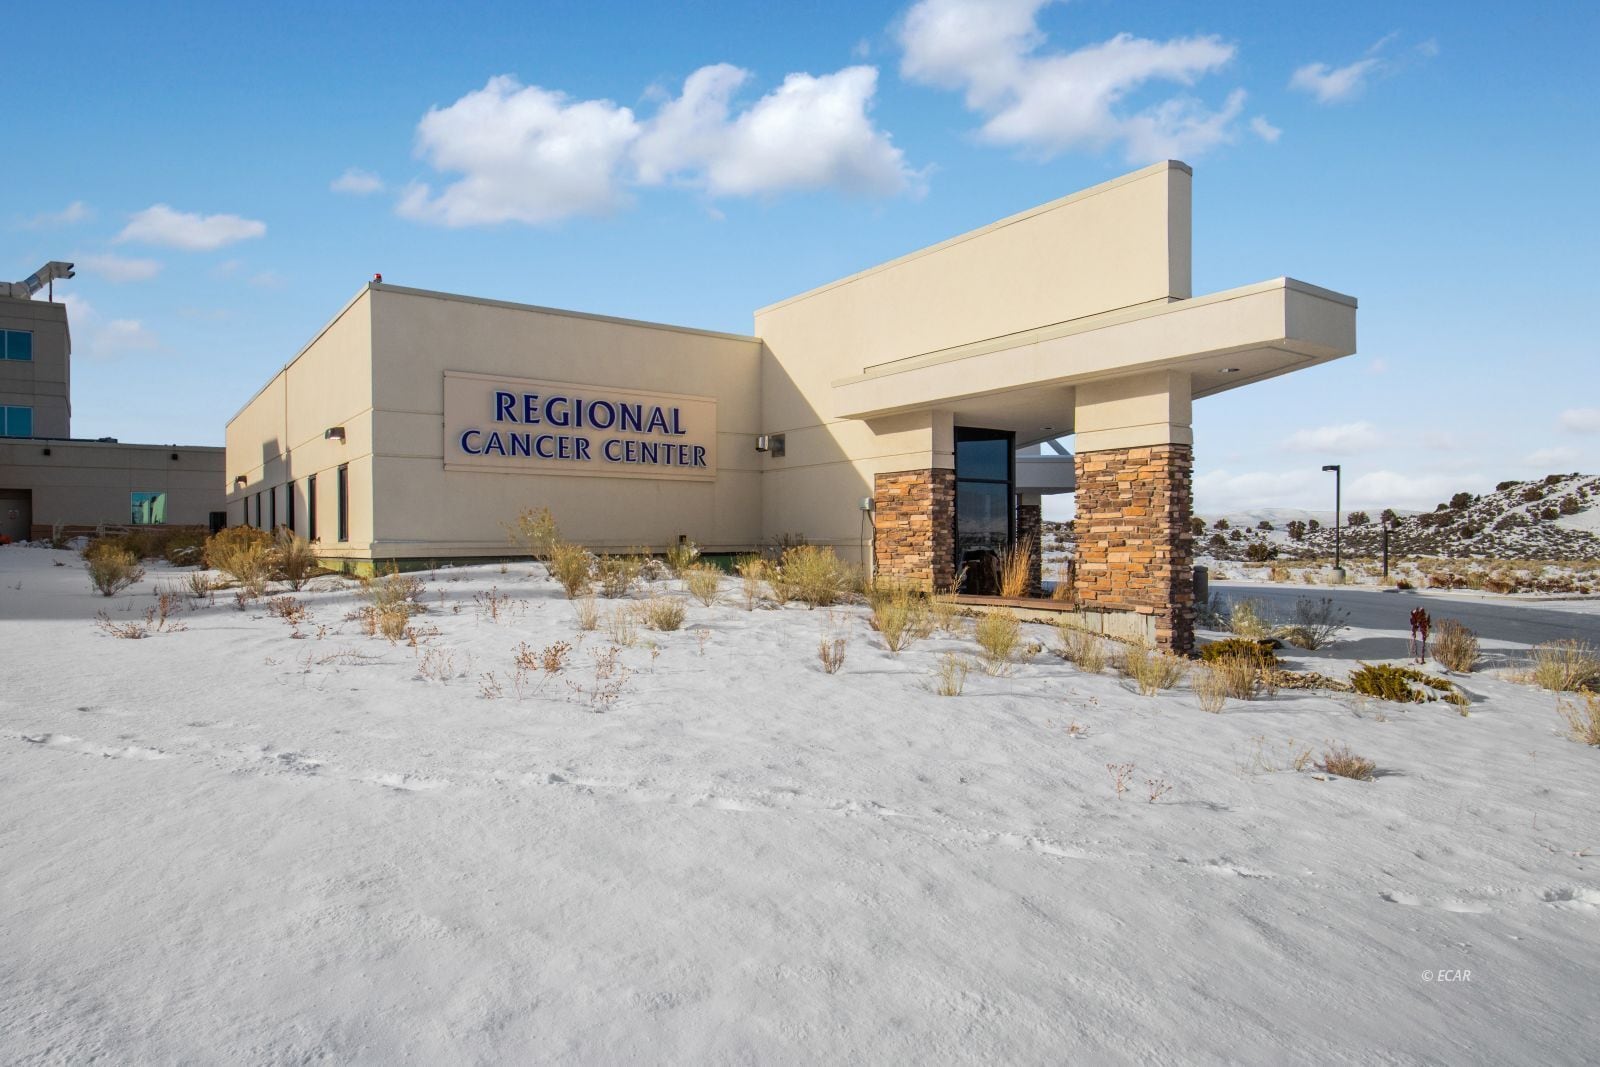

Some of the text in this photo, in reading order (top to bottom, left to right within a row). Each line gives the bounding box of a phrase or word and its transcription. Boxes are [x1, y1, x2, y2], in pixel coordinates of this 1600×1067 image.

[494, 390, 687, 436] REGIONAL
[460, 429, 708, 468] CANCER CENTER
